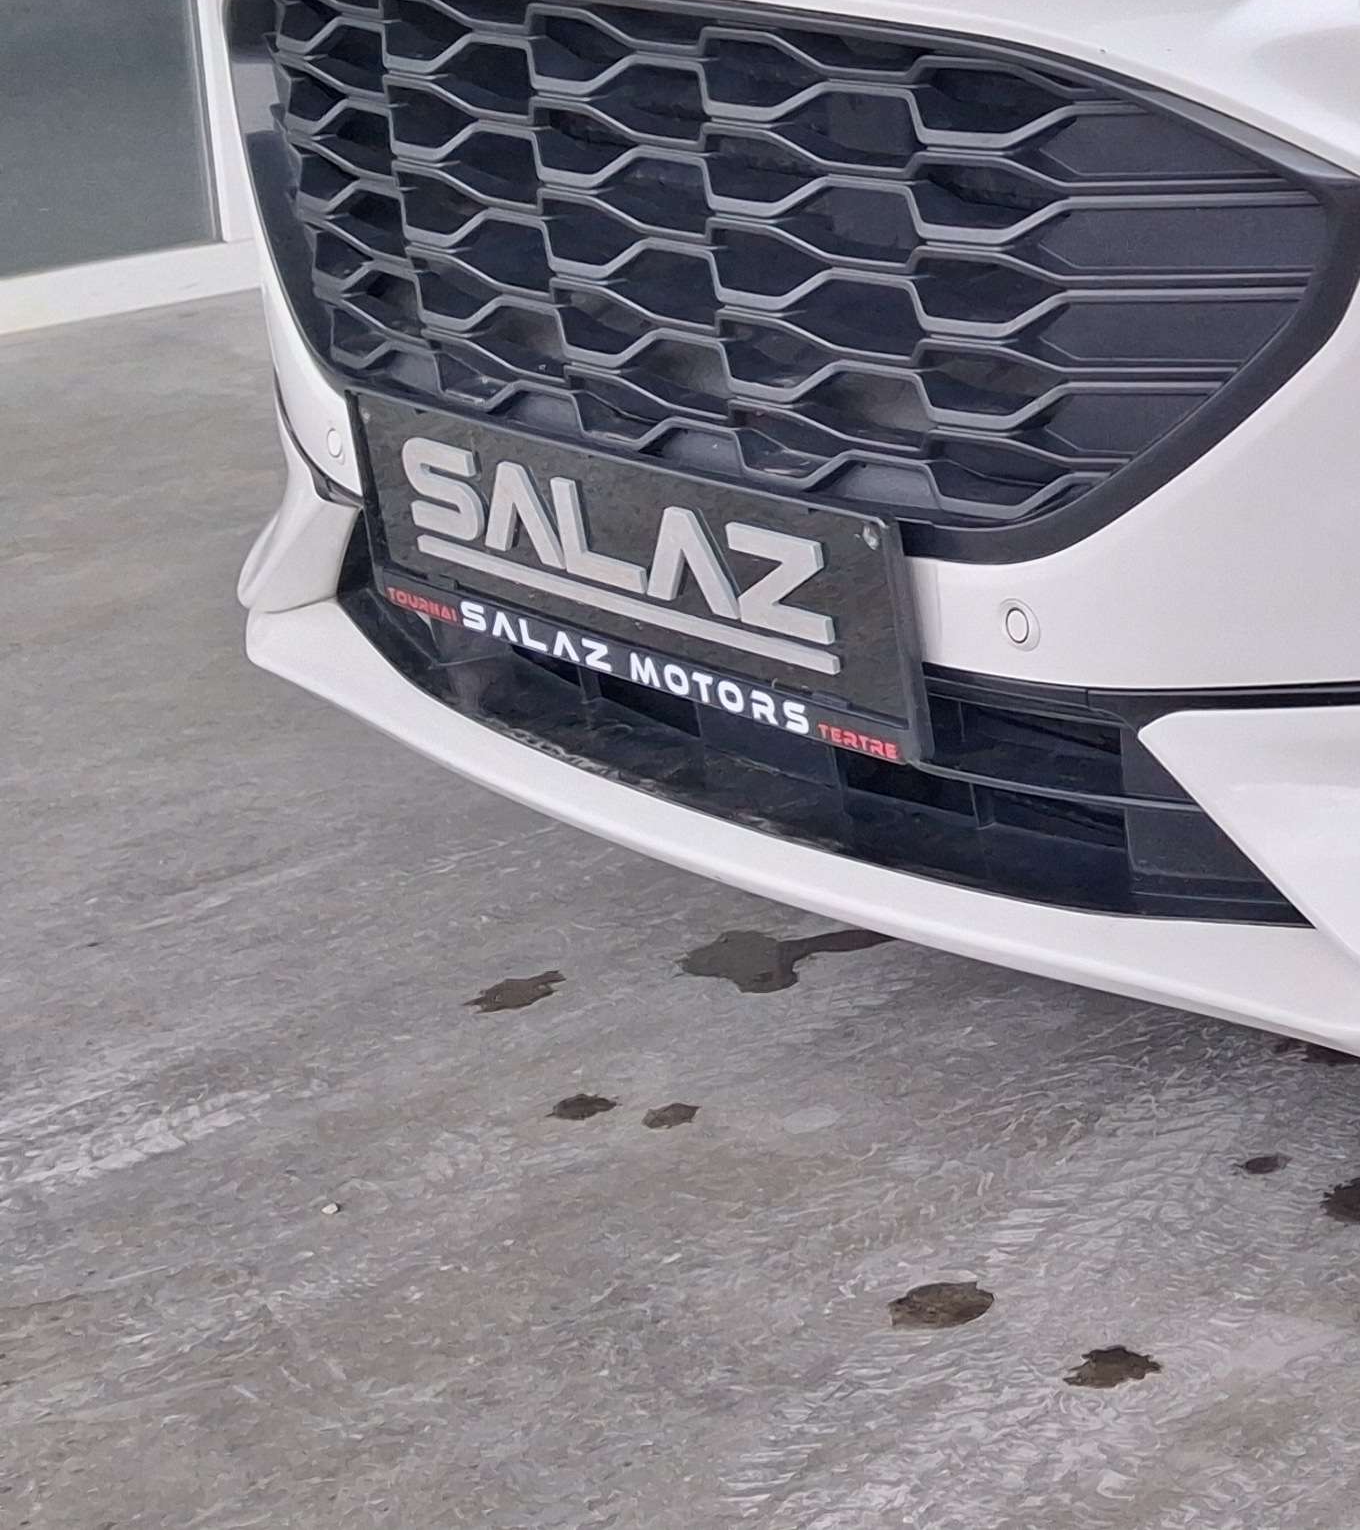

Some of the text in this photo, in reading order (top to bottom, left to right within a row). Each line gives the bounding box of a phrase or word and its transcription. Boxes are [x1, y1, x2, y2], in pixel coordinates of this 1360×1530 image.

[401, 436, 836, 646] SALAZ
[385, 586, 899, 760] TOURNAI SALAZ MOTORS TERTRE
